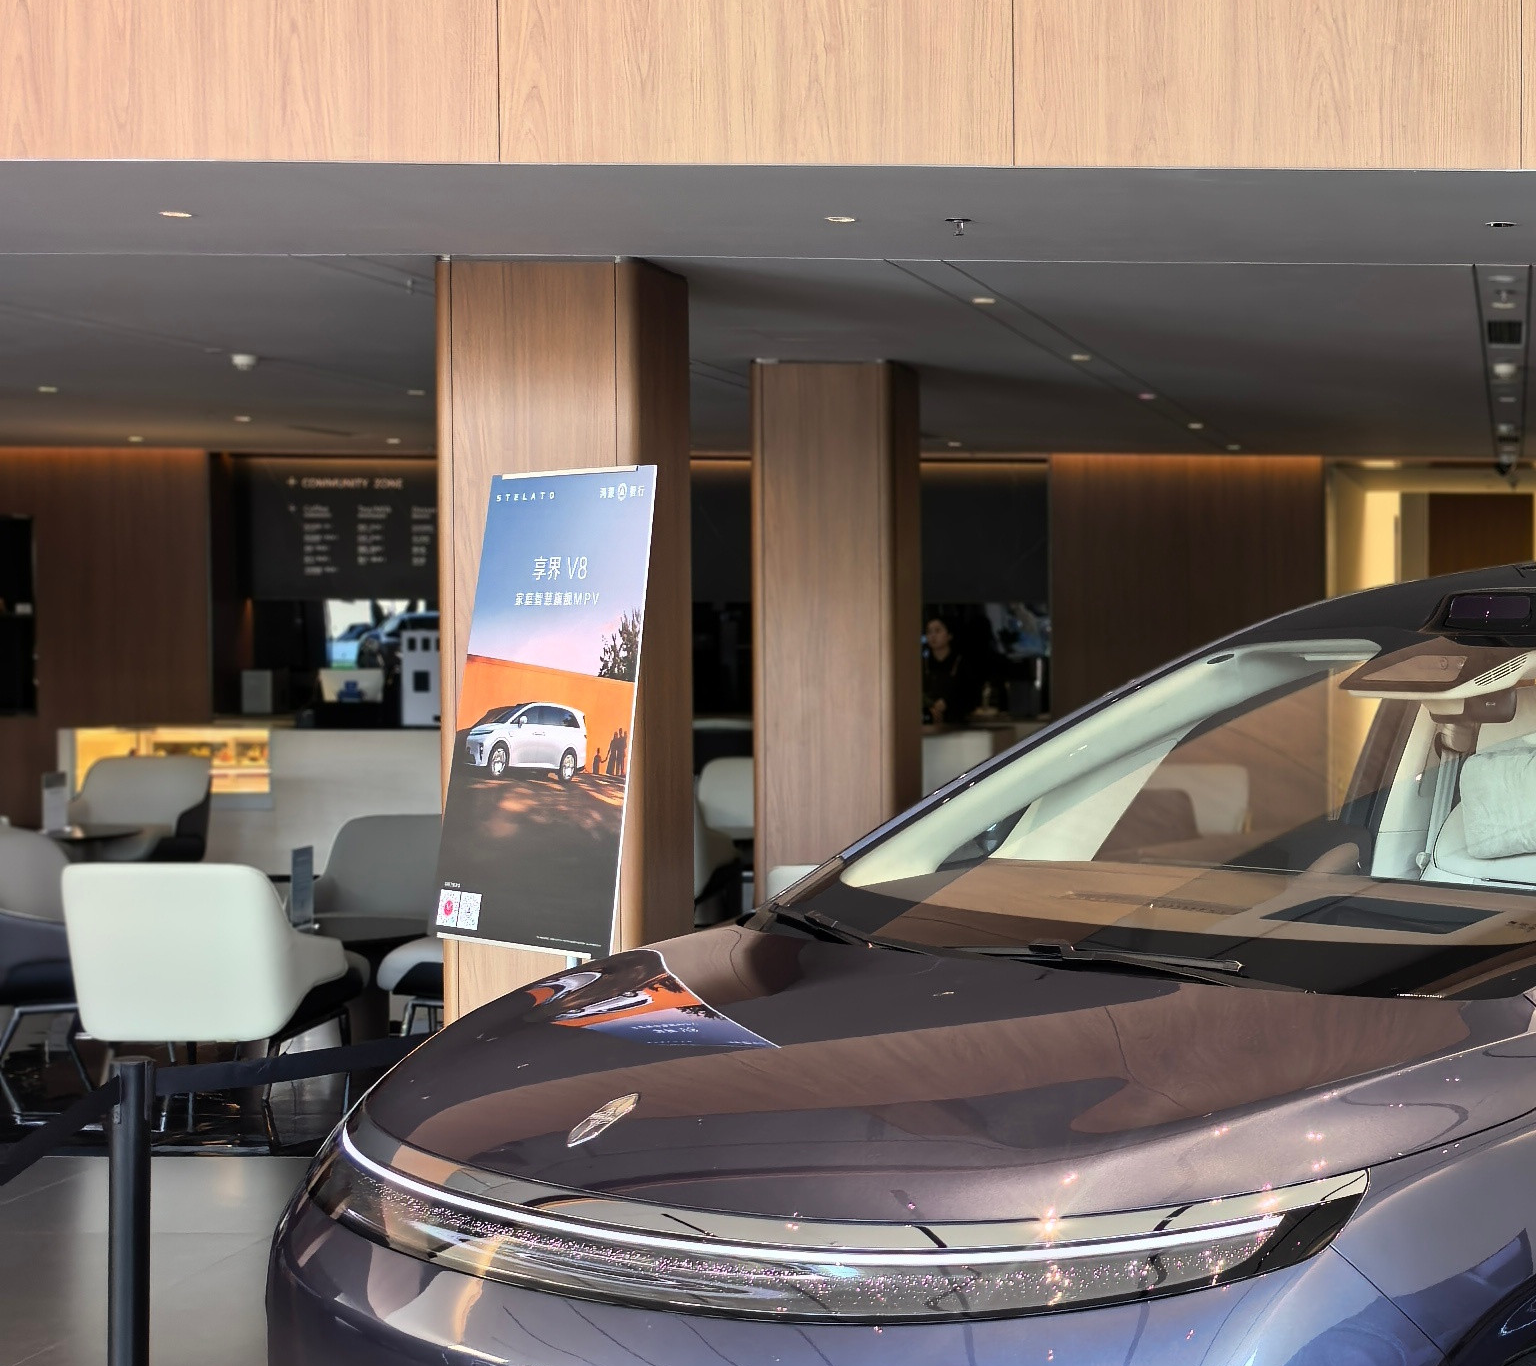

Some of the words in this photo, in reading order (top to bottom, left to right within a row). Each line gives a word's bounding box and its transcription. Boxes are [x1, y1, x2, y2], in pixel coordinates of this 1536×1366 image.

[301, 477, 369, 489] COMMUNITY
[374, 477, 403, 490] ZONE
[495, 491, 556, 503] STELATO
[532, 556, 562, 581] 享界
[567, 556, 588, 580] V8
[514, 592, 600, 607] 家庭智慧旗舰MPV
